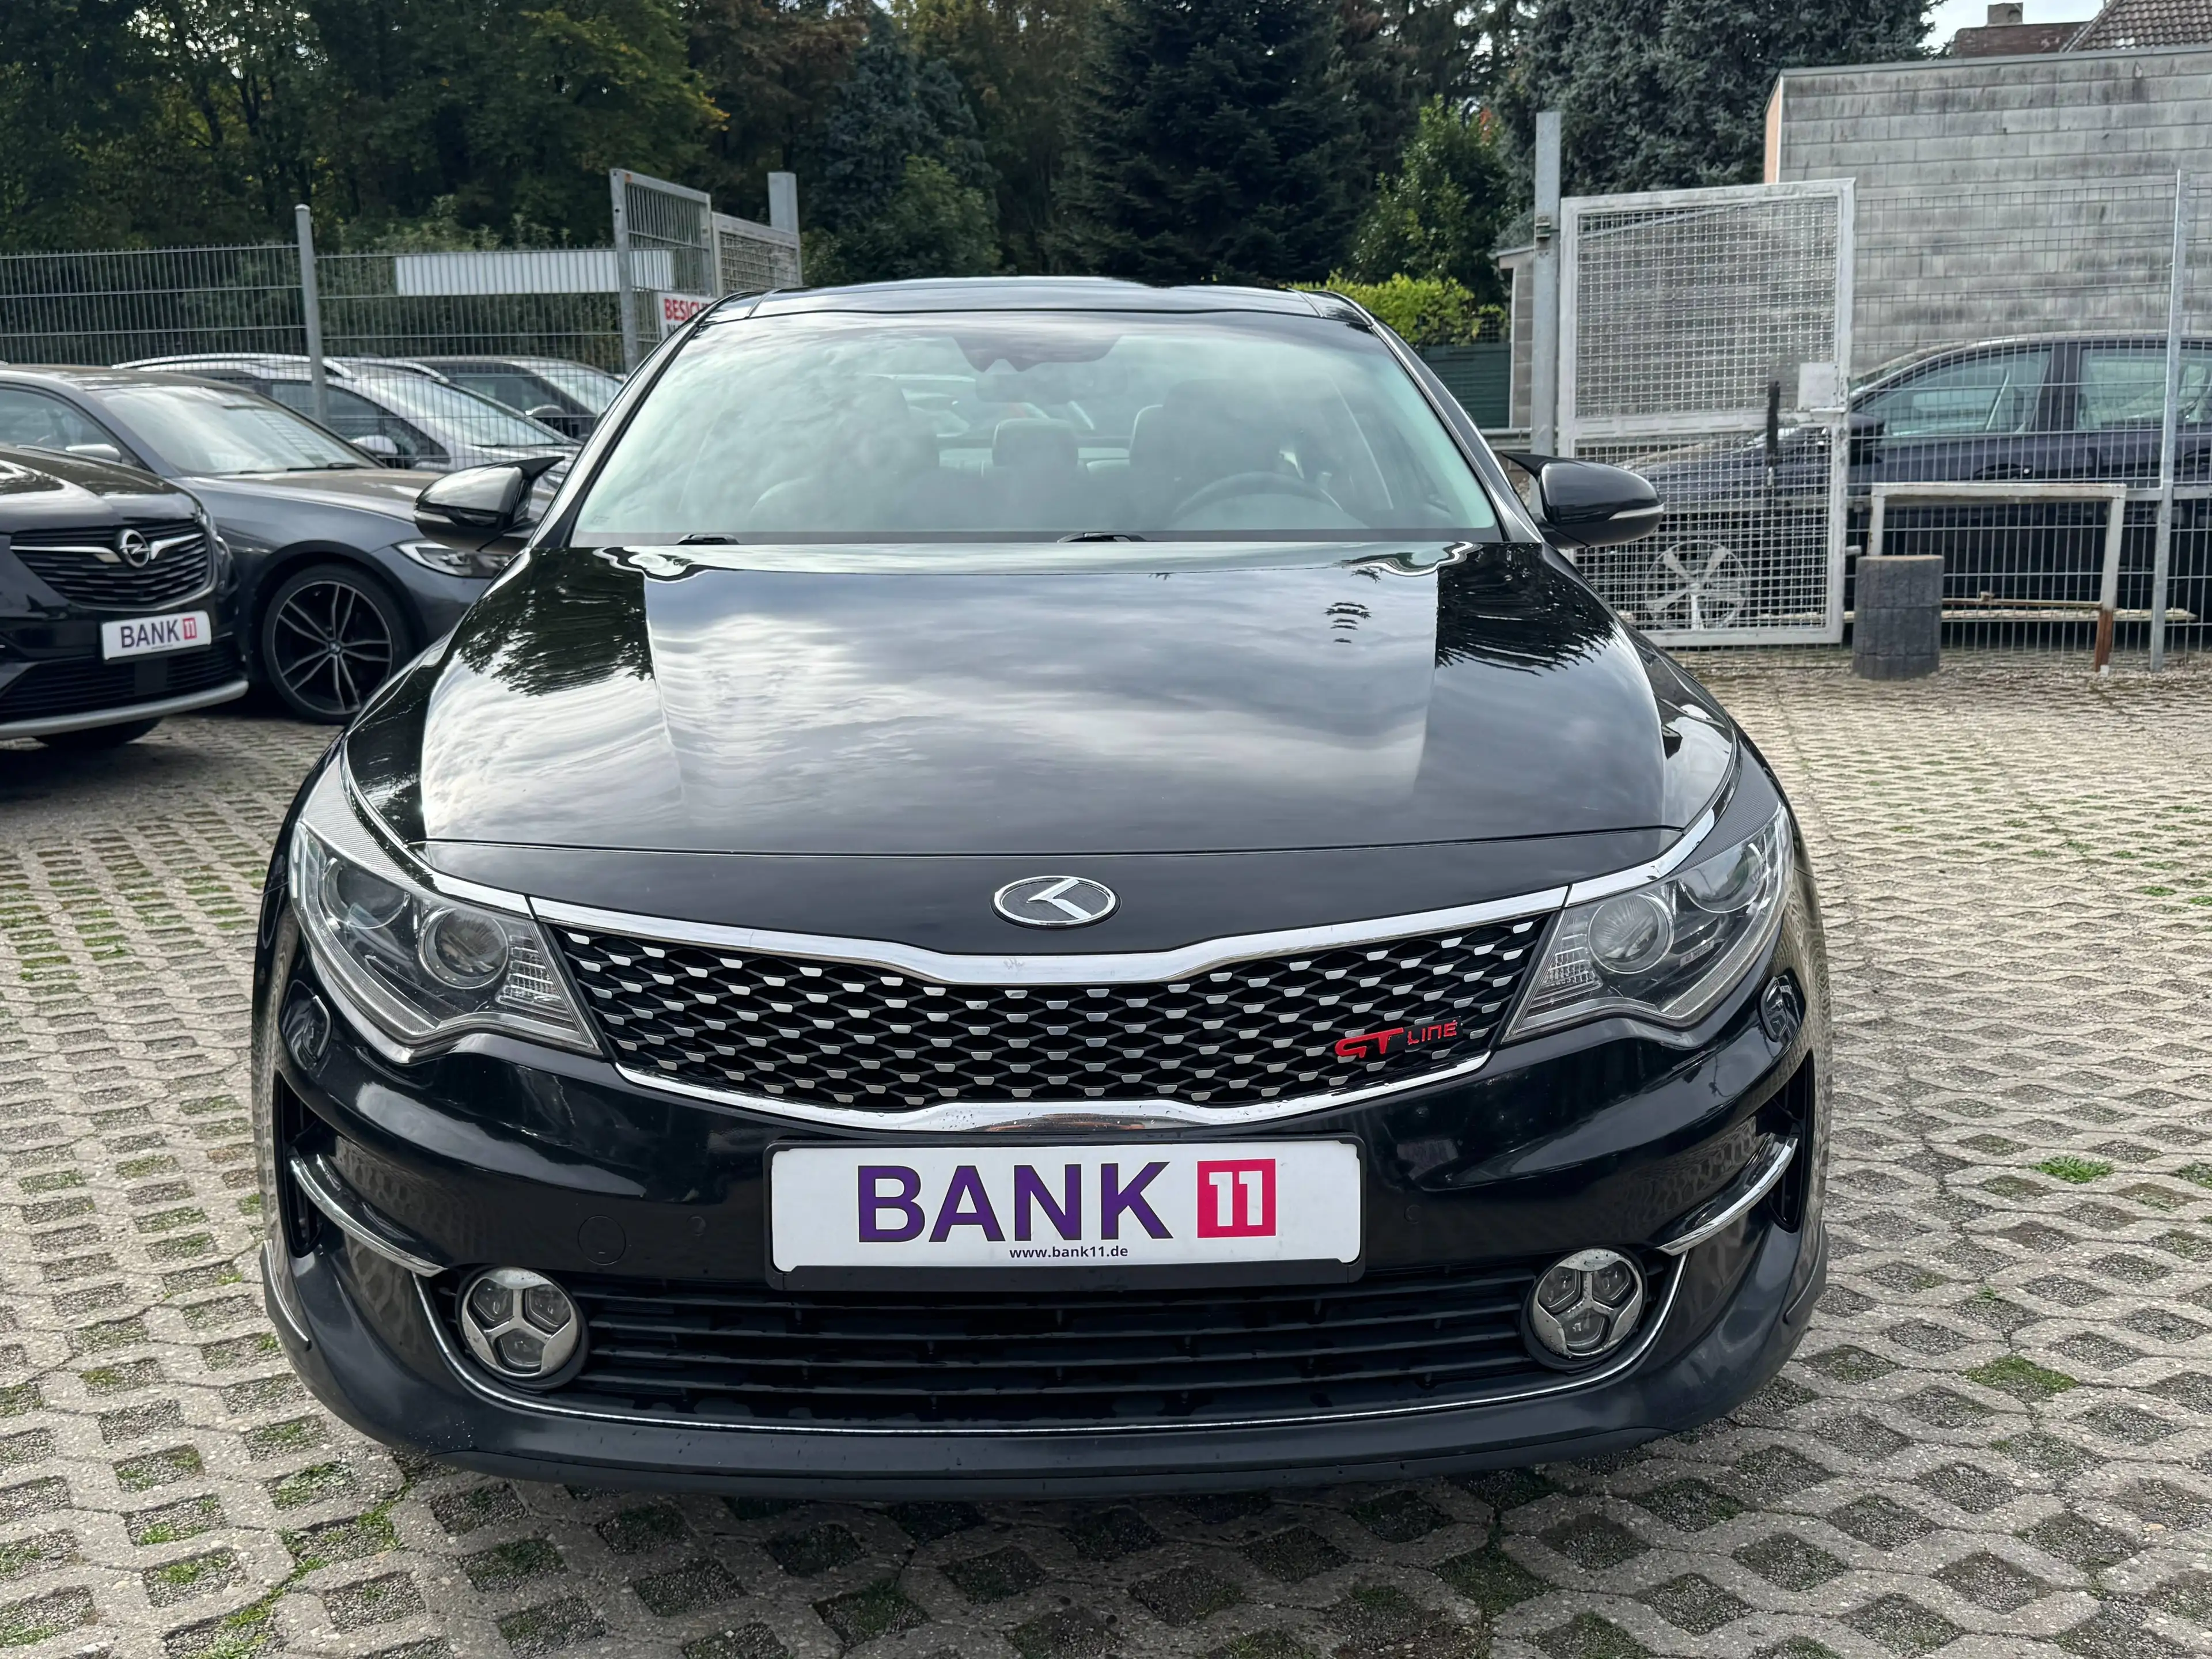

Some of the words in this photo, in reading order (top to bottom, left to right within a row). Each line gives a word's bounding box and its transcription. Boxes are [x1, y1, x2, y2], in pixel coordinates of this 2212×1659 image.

[120, 619, 180, 649] BANK
[183, 619, 196, 638] 11
[1335, 1027, 1404, 1058] GT
[1407, 1020, 1458, 1046] LINE
[858, 1161, 1174, 1243] BANK
[1206, 1168, 1266, 1230] 11
[1009, 1245, 1128, 1259] www.bank11.de
